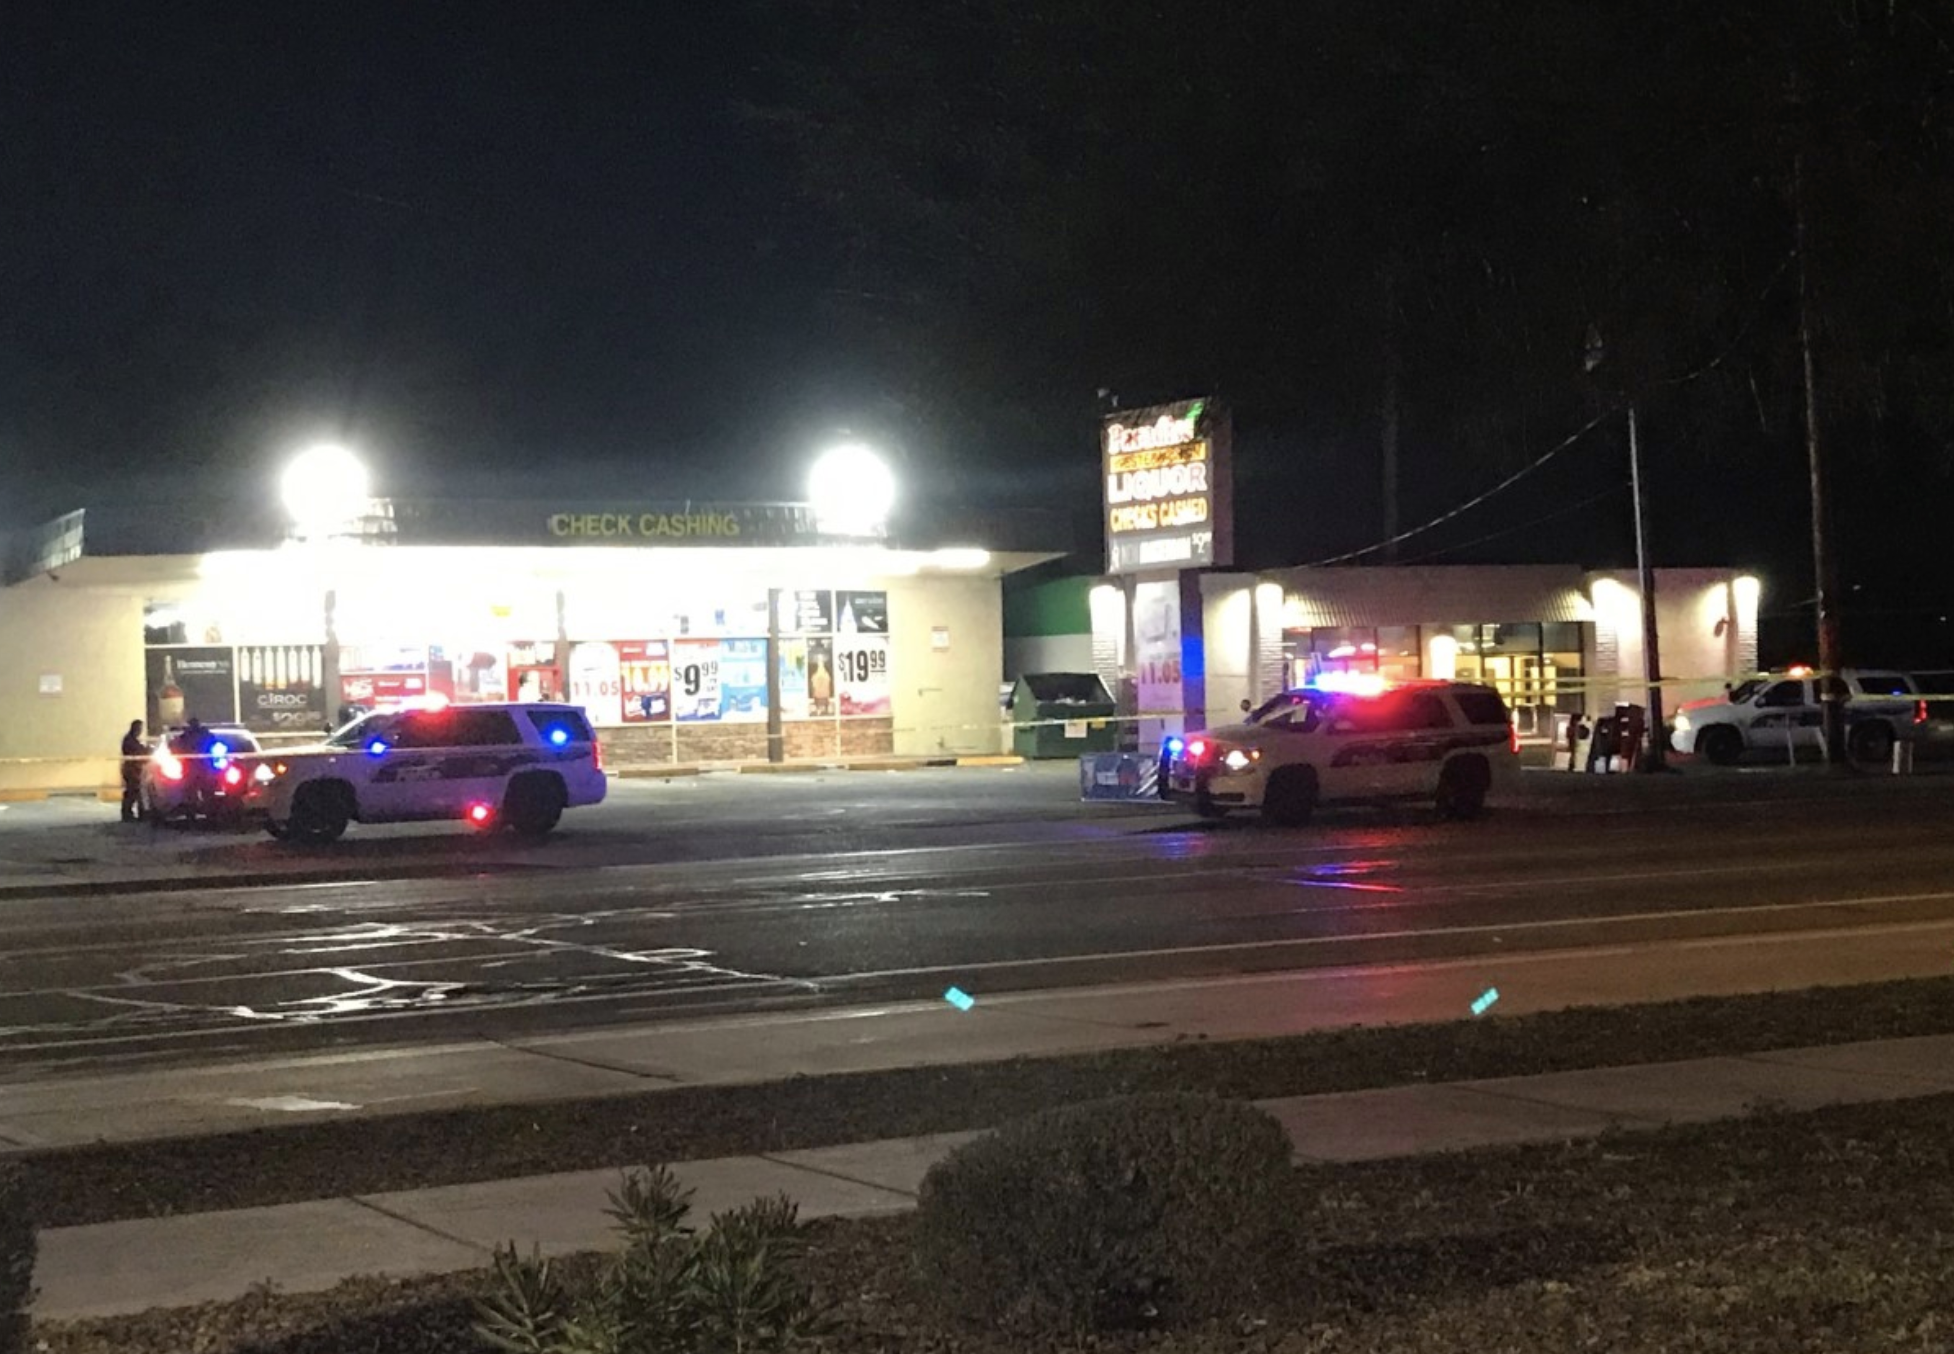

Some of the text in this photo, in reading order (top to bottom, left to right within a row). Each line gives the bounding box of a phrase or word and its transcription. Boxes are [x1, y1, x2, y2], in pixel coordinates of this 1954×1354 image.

[1107, 462, 1208, 503] LIQUOR
[552, 513, 740, 537] CHECK CASHING
